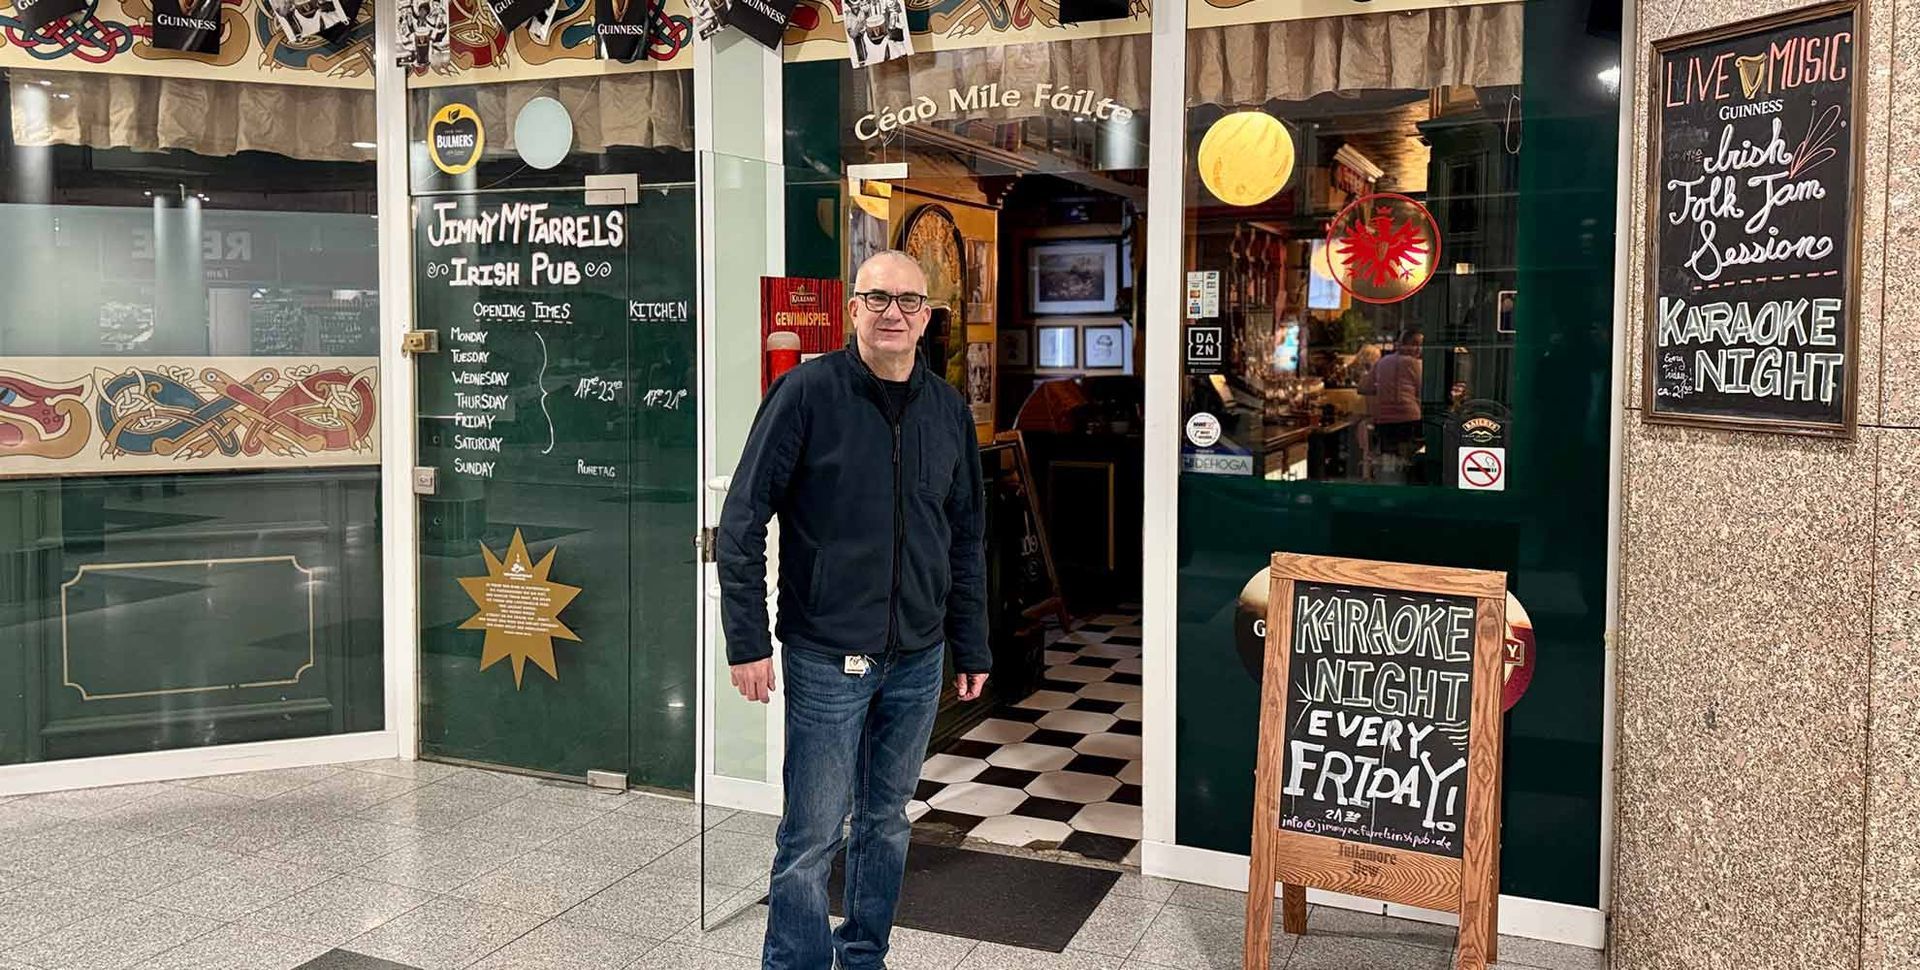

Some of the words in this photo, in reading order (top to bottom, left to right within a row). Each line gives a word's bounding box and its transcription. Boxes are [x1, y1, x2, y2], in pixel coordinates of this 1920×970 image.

[157, 13, 217, 31] GUINNESS
[597, 23, 643, 35] GUINNESS
[1666, 52, 1735, 108] LIVE
[1767, 32, 1851, 94] MUSIC
[854, 96, 938, 141] Céad
[949, 82, 1021, 112] Míle
[1034, 83, 1134, 123] Fáilte
[1719, 99, 1784, 121] GUINNESS
[436, 134, 474, 149] BULMERS
[1703, 117, 1794, 174] Irish
[1667, 175, 1745, 226] Folk
[1744, 171, 1826, 234] Jam
[427, 202, 499, 247] JIMMY
[1683, 220, 1834, 281] Session
[449, 257, 520, 286] IRISH
[531, 252, 582, 286] PUB
[473, 302, 526, 318] OPENING
[531, 302, 572, 319] TIMES
[629, 300, 688, 318] KITCHEN
[775, 311, 831, 327] GEWINNSPIEL
[1658, 296, 1841, 347] KARAOKE
[450, 327, 489, 343] MONDAY
[451, 349, 490, 363] TUESDAY
[452, 371, 510, 386] WEDNESDAY
[1694, 347, 1844, 403] NIGHT
[455, 393, 508, 409] THURSDAY
[455, 412, 496, 430] FRIDAY
[454, 435, 503, 452] SATURDAY
[454, 457, 495, 477] SUNDAY
[577, 459, 616, 478] RUHETAG
[1295, 595, 1473, 662] KARAOKE
[1314, 657, 1469, 721] NIGHT
[1308, 709, 1435, 759] EVERY
[1283, 740, 1467, 832] FRIDAY!
[1338, 841, 1397, 866] Tullamore
[1353, 860, 1380, 876] Dew
